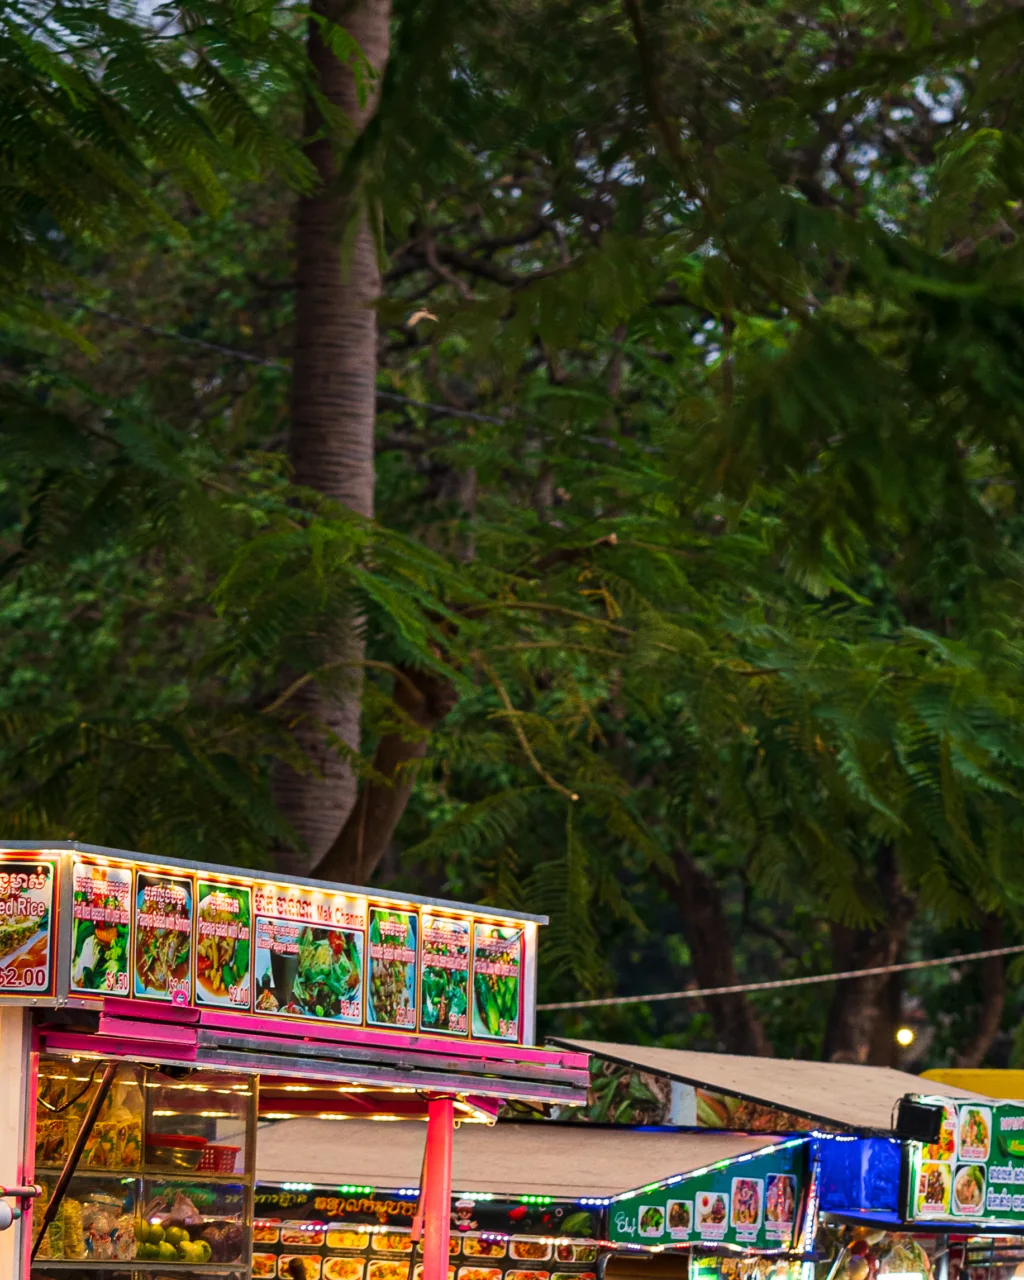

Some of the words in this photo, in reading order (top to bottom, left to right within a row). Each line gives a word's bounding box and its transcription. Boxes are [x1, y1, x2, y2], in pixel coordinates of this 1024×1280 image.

[17, 898, 45, 916] Rice
[316, 904, 333, 922] Mak
[335, 908, 365, 927] Channa
[106, 971, 128, 991] $1.50
[228, 983, 249, 1005] $2.00
